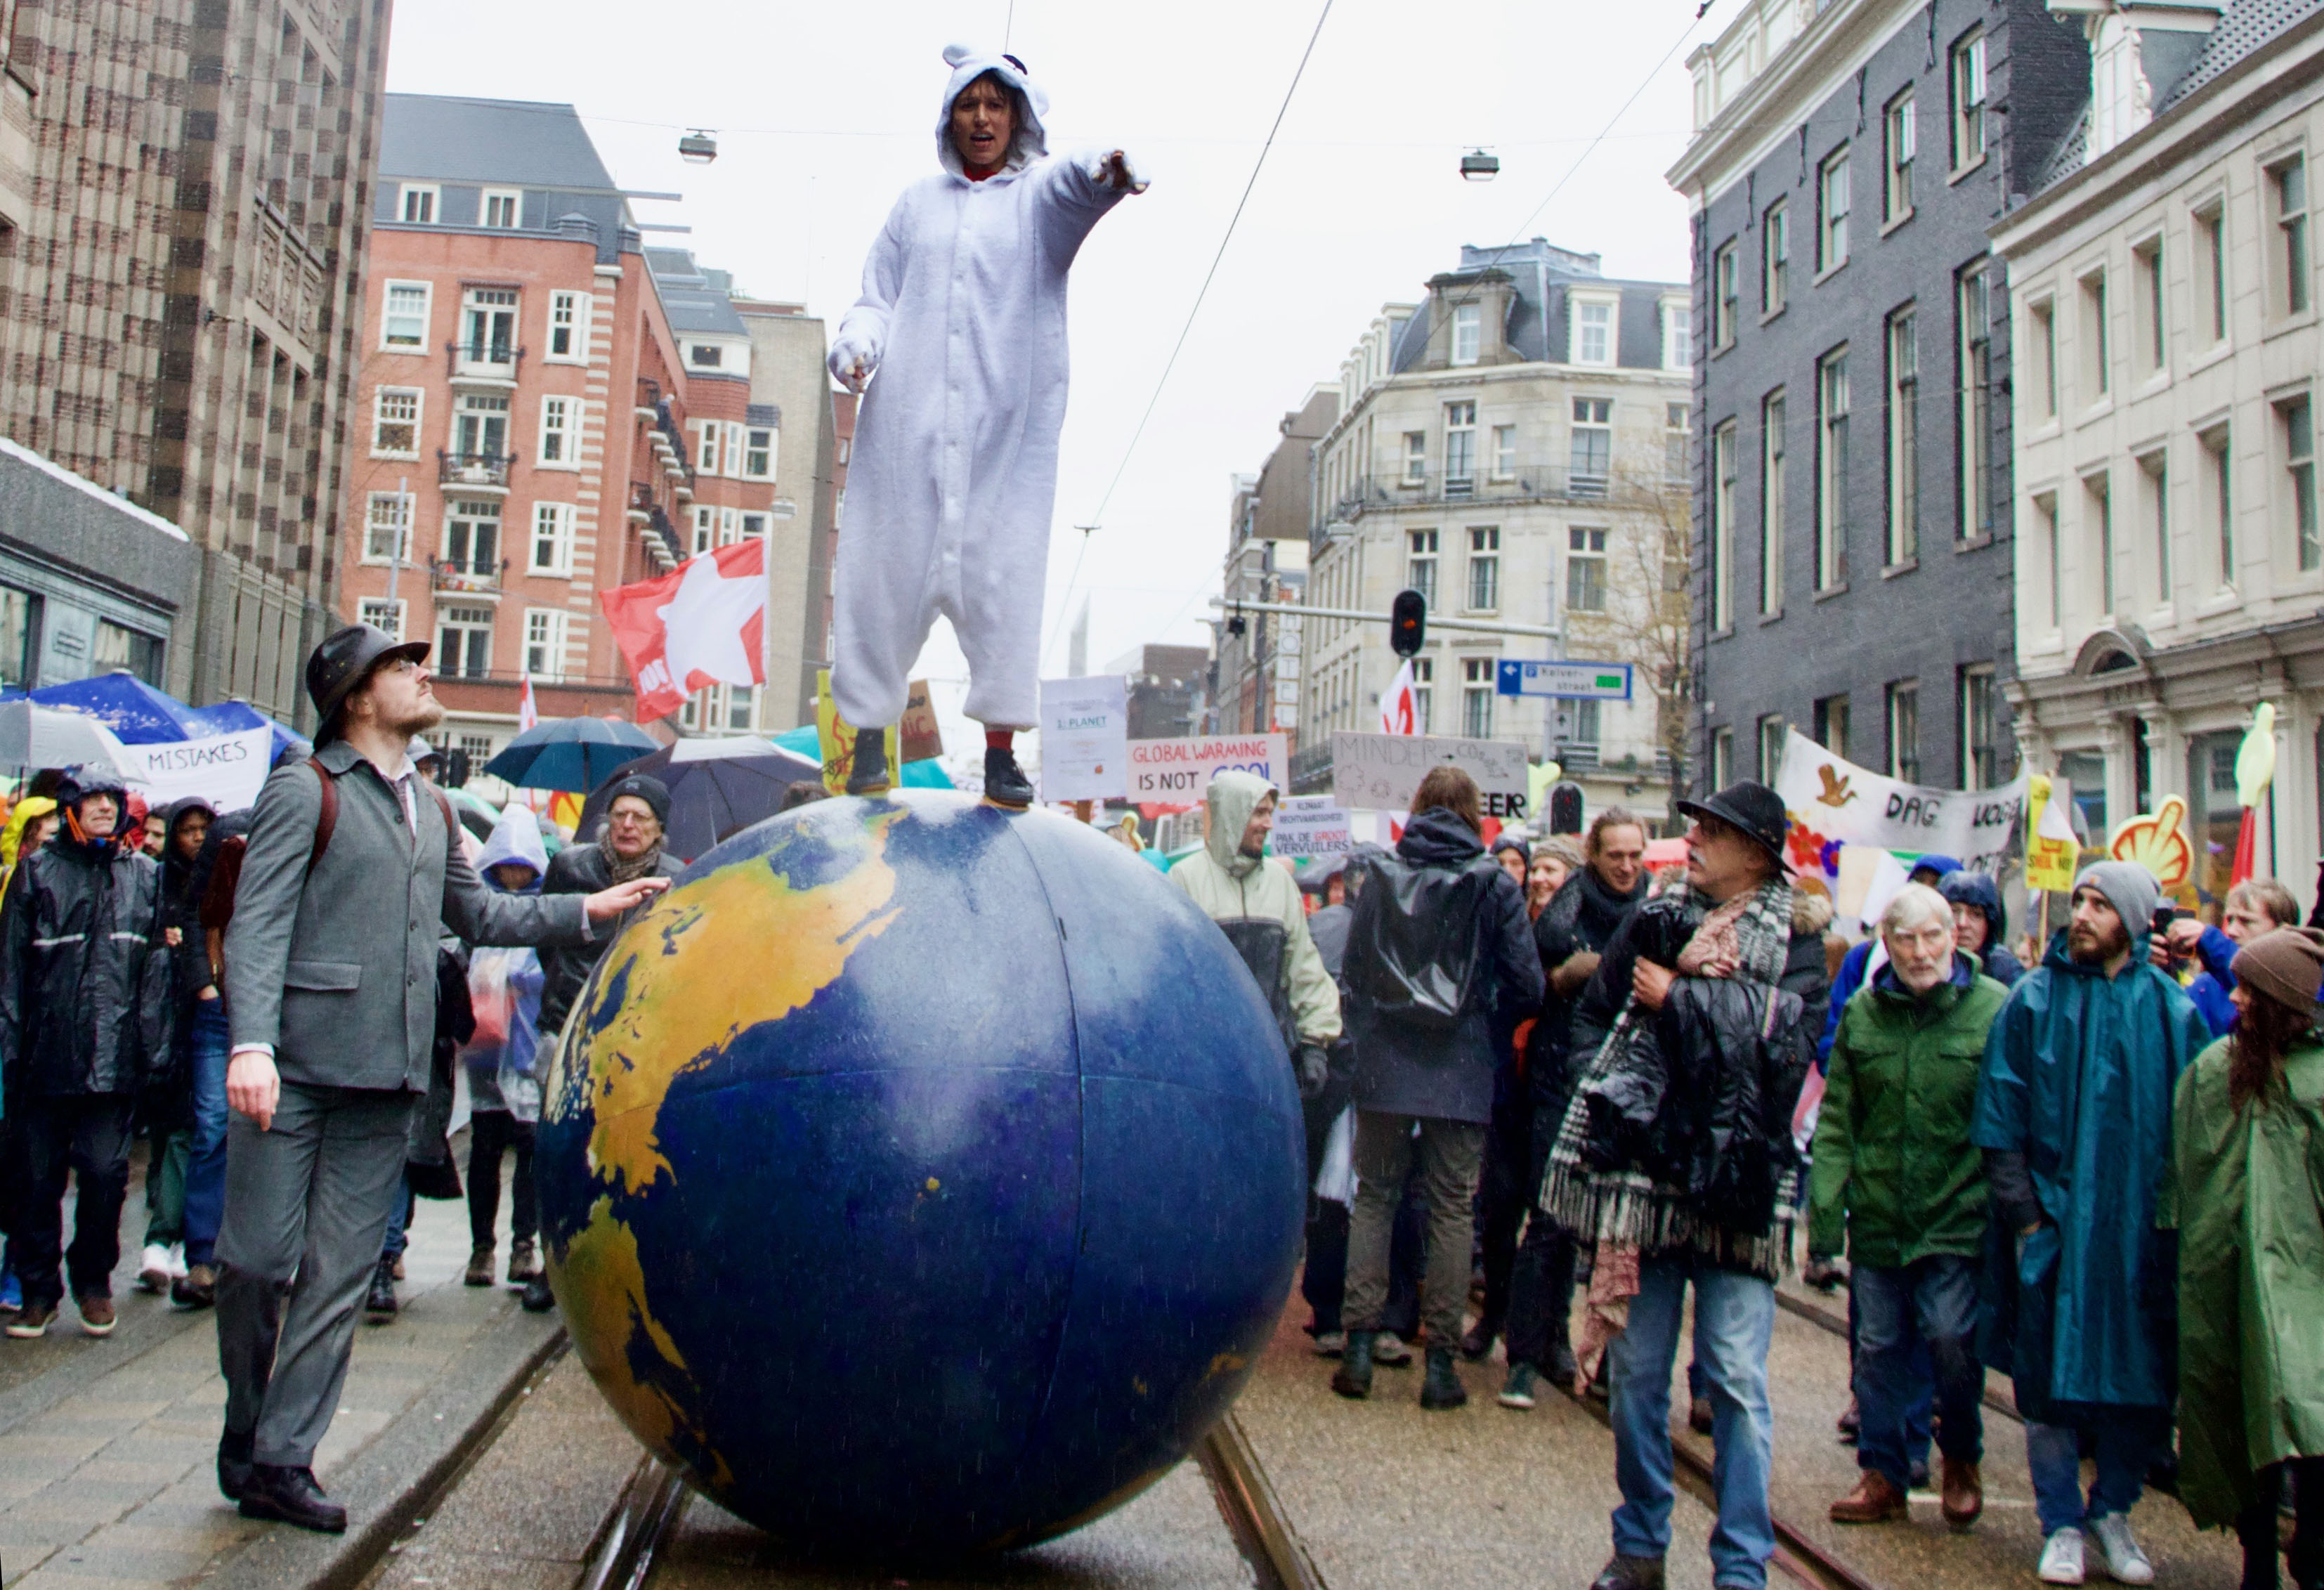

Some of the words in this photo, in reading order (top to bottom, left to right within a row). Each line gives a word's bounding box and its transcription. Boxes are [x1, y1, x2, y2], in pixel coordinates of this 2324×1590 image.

[1069, 715, 1106, 727] PLANET
[148, 741, 247, 771] MISTAKES
[1133, 744, 1189, 763] GLOBAL
[1192, 740, 1266, 760] WARMING
[1340, 736, 1437, 767] MINDER
[1139, 774, 1154, 790] IS
[1160, 771, 1199, 790] NOT
[1885, 793, 1940, 826] DAG
[1314, 829, 1347, 842] GROOT
[1276, 840, 1349, 854] VERVUILERS
